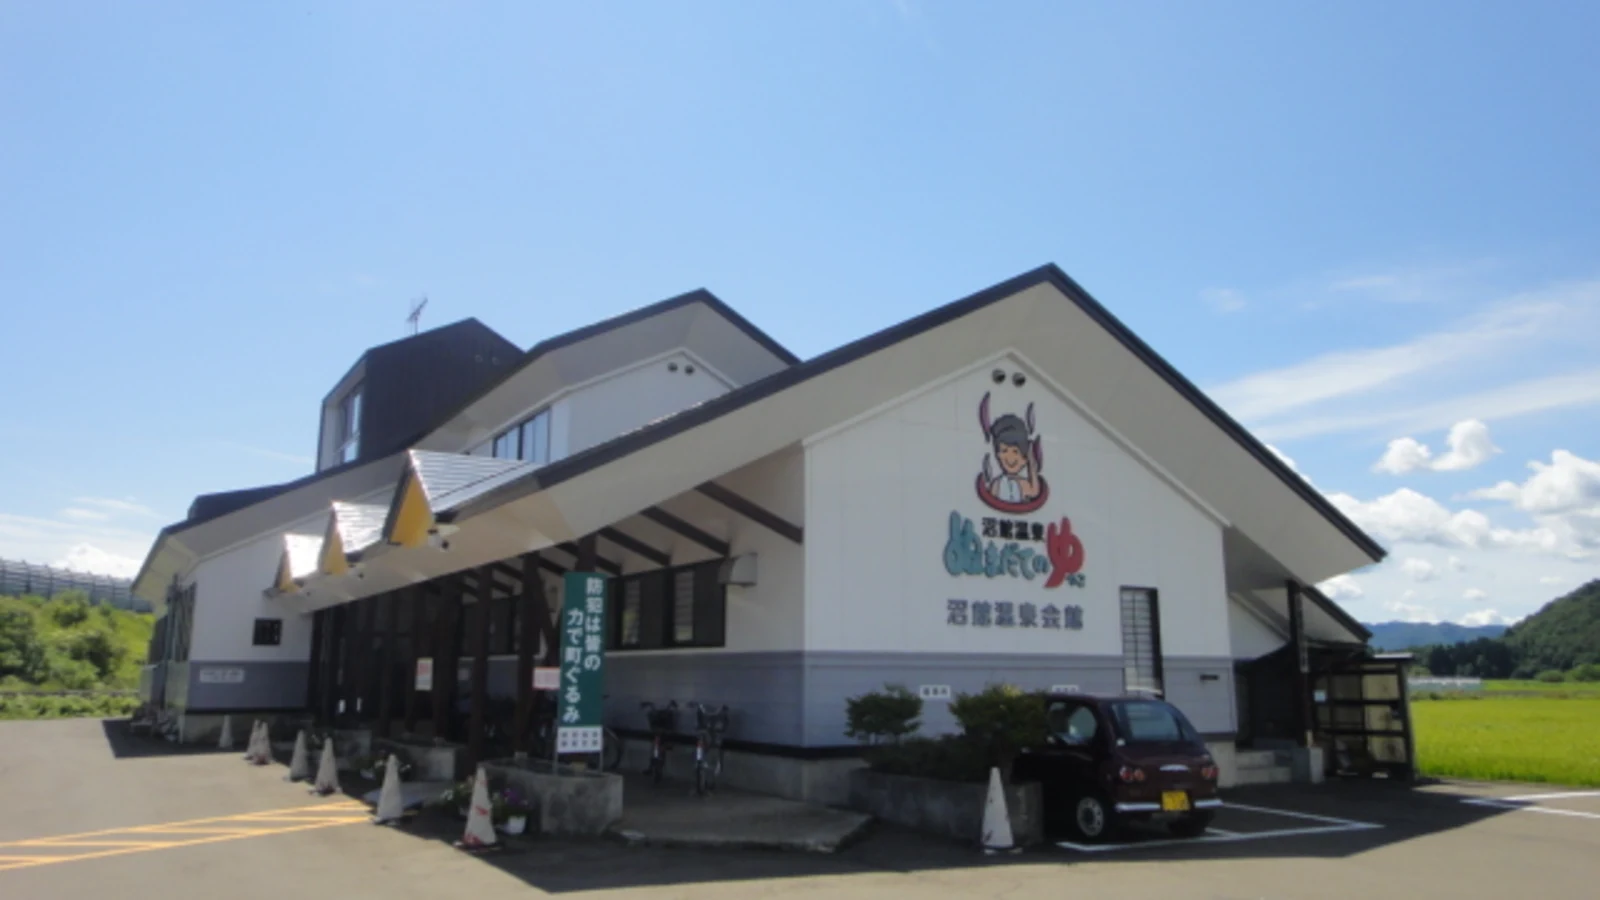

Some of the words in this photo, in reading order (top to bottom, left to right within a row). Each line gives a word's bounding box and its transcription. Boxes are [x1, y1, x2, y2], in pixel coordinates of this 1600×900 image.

[562, 608, 583, 723] 力で町ぐるみ
[584, 577, 604, 671] 防犯は皆の
